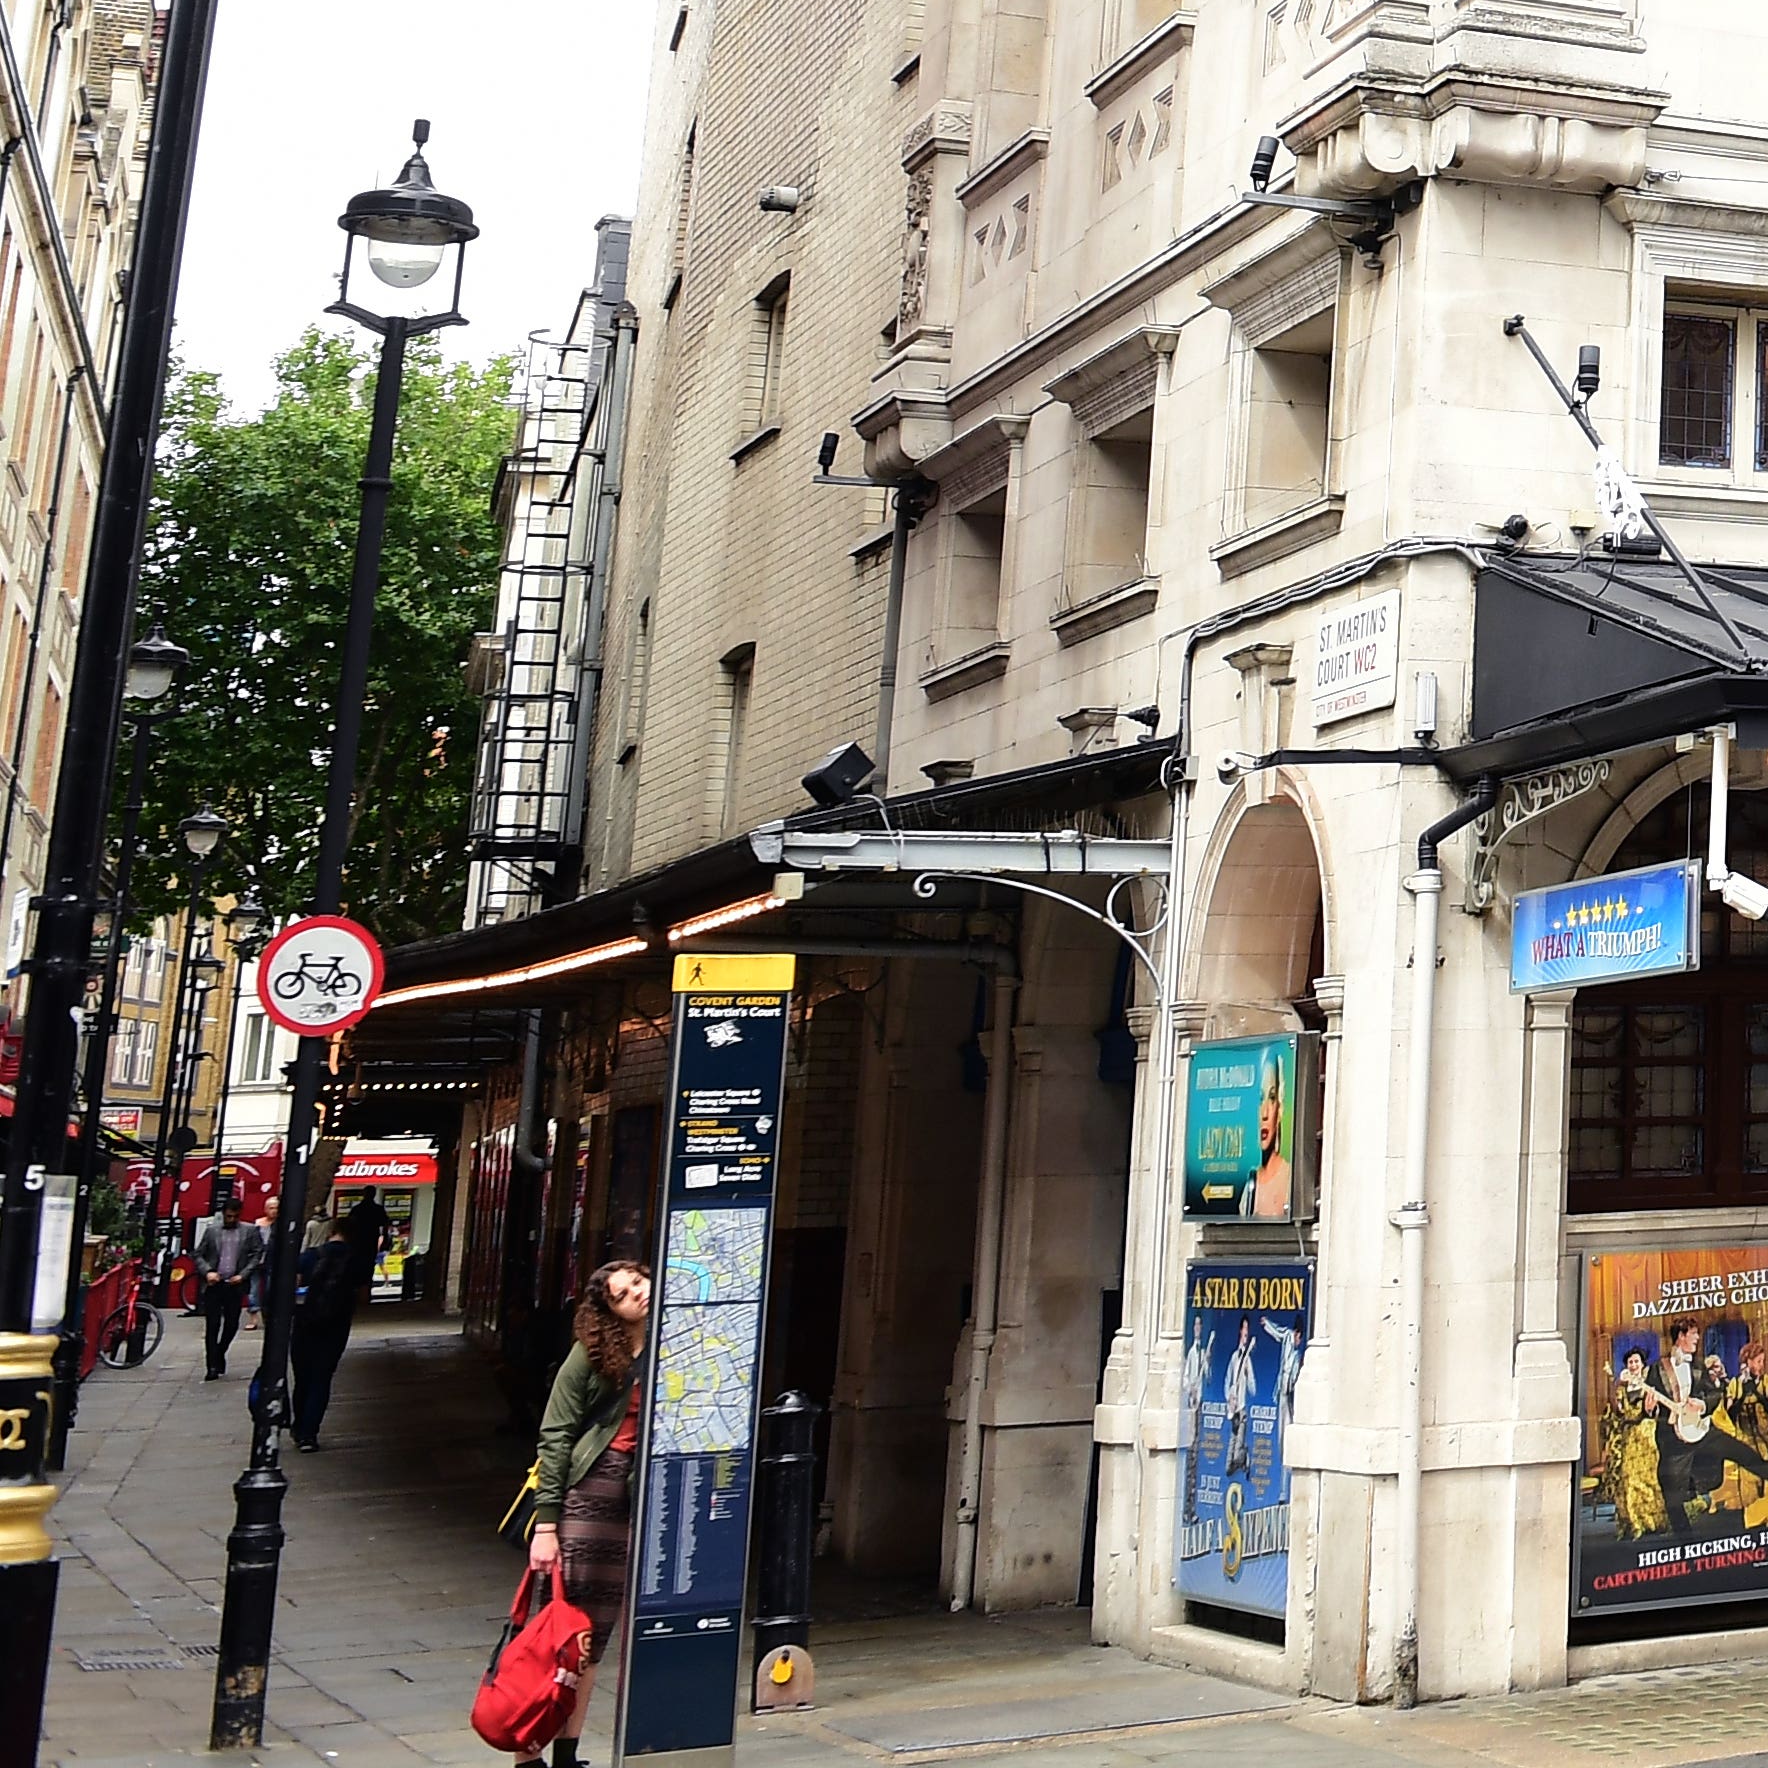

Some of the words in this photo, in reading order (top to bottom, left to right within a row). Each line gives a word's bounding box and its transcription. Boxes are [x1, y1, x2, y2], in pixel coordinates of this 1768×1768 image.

[1336, 605, 1387, 647] MARTIN'S
[1317, 651, 1351, 687] COURT
[1354, 643, 1377, 675] WC2
[1531, 932, 1574, 966] WHAT
[1576, 931, 1585, 958] A
[1587, 922, 1663, 958] TRIUMPH!
[688, 996, 736, 1007] COVENT
[736, 996, 782, 1007] GARDEN
[703, 1007, 748, 1018] Martin's
[749, 1006, 782, 1018] Court
[296, 1144, 309, 1165] 1
[1198, 1125, 1223, 1160] LADY
[1224, 1124, 1243, 1158] DAY
[24, 1164, 46, 1190] 5
[334, 1159, 420, 1177] adbrokes
[79, 1185, 89, 1196] 2
[1191, 1278, 1203, 1309] A
[1204, 1277, 1240, 1310] STAR
[1241, 1278, 1257, 1309] IS
[1258, 1278, 1305, 1311] BORN
[1632, 1292, 1727, 1319] DAZZLING
[1180, 1518, 1215, 1561] HALF
[1215, 1518, 1225, 1553] A
[1638, 1546, 1682, 1567] HIGH
[1685, 1534, 1757, 1558] KICKING,
[1593, 1561, 1692, 1591] CARTWHEEL
[1694, 1550, 1766, 1572] TURNING
